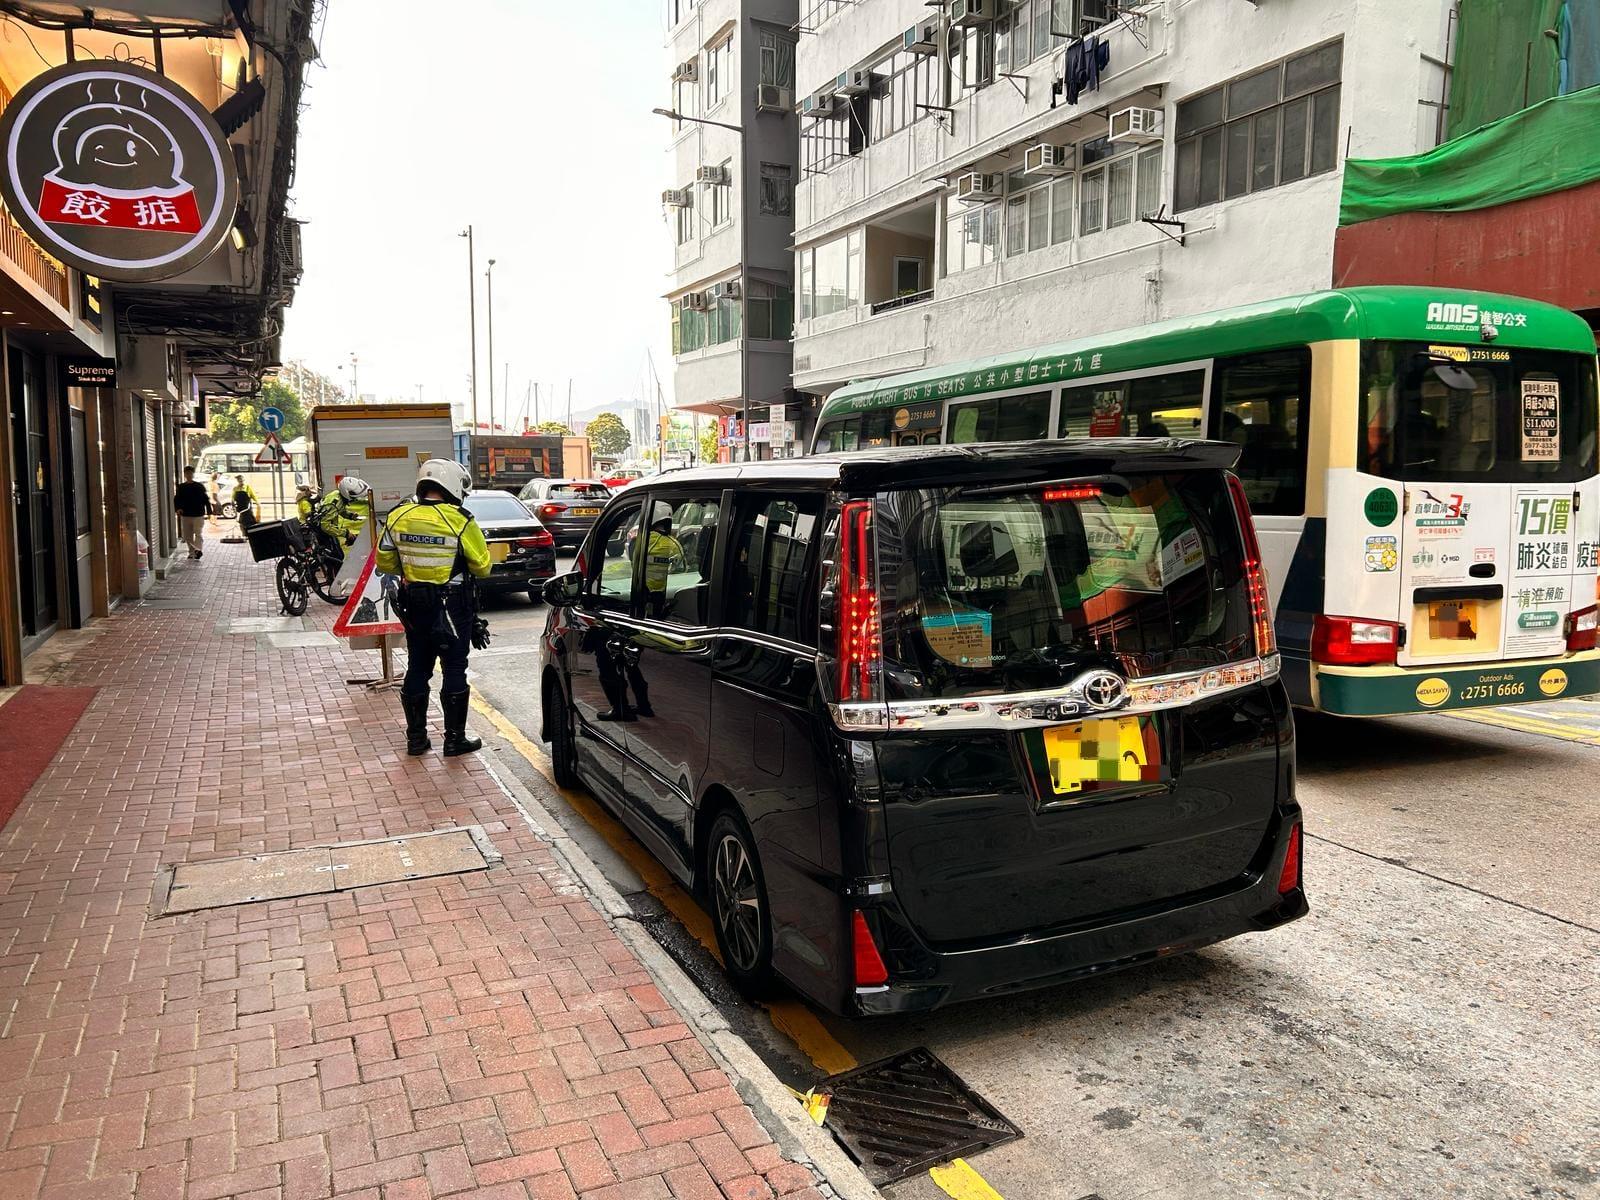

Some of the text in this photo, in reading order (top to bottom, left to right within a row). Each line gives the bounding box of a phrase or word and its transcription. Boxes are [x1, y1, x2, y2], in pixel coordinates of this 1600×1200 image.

[60, 190, 181, 226] 餃掂
[1427, 302, 1478, 324] AMS
[1480, 311, 1527, 327] 進智公交
[1472, 350, 1490, 359] 2751
[1491, 351, 1510, 360] 6666
[68, 364, 115, 376] Supreme
[973, 353, 1103, 389] 公共小型巴士十九座
[877, 389, 899, 406] LIGHT
[903, 385, 918, 401] BUS
[923, 384, 932, 398] 19
[937, 377, 966, 395] SEATS
[1520, 498, 1571, 535] 15價
[408, 535, 435, 544] POLICE
[1516, 541, 1551, 570] 肺炎
[1479, 673, 1514, 683] Outdoor Ads
[1466, 682, 1525, 699] 2751 6666
